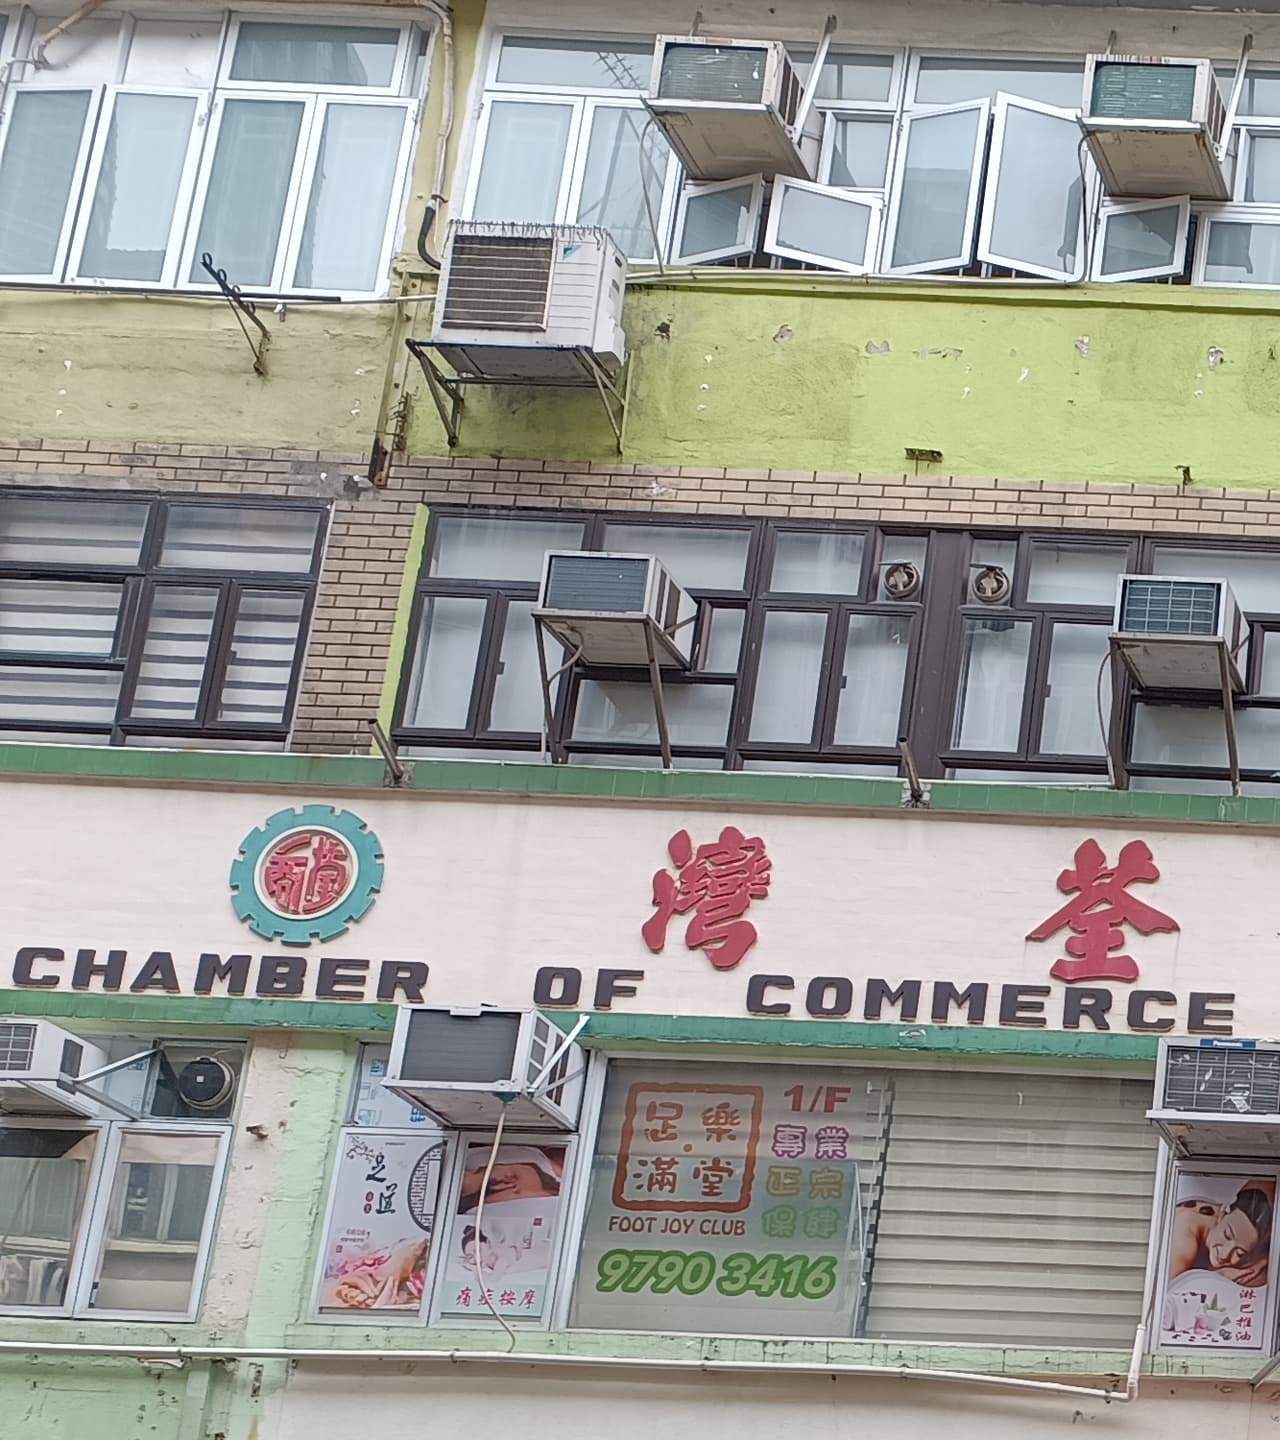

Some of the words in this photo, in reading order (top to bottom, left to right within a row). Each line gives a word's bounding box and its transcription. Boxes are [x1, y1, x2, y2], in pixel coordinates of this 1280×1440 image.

[13, 945, 429, 1004] CHAMBER
[533, 966, 644, 1010] OF
[746, 974, 1236, 1037] COMMERCE
[784, 1085, 852, 1113] 1/F
[772, 1124, 848, 1159] 專業
[633, 1157, 734, 1196] 滿堂
[767, 1165, 844, 1199] 正宗
[608, 1216, 656, 1233] FOOT
[661, 1217, 695, 1235] JOY
[700, 1219, 745, 1236] CLUB
[596, 1249, 716, 1295] 9790
[716, 1253, 837, 1299] 3416
